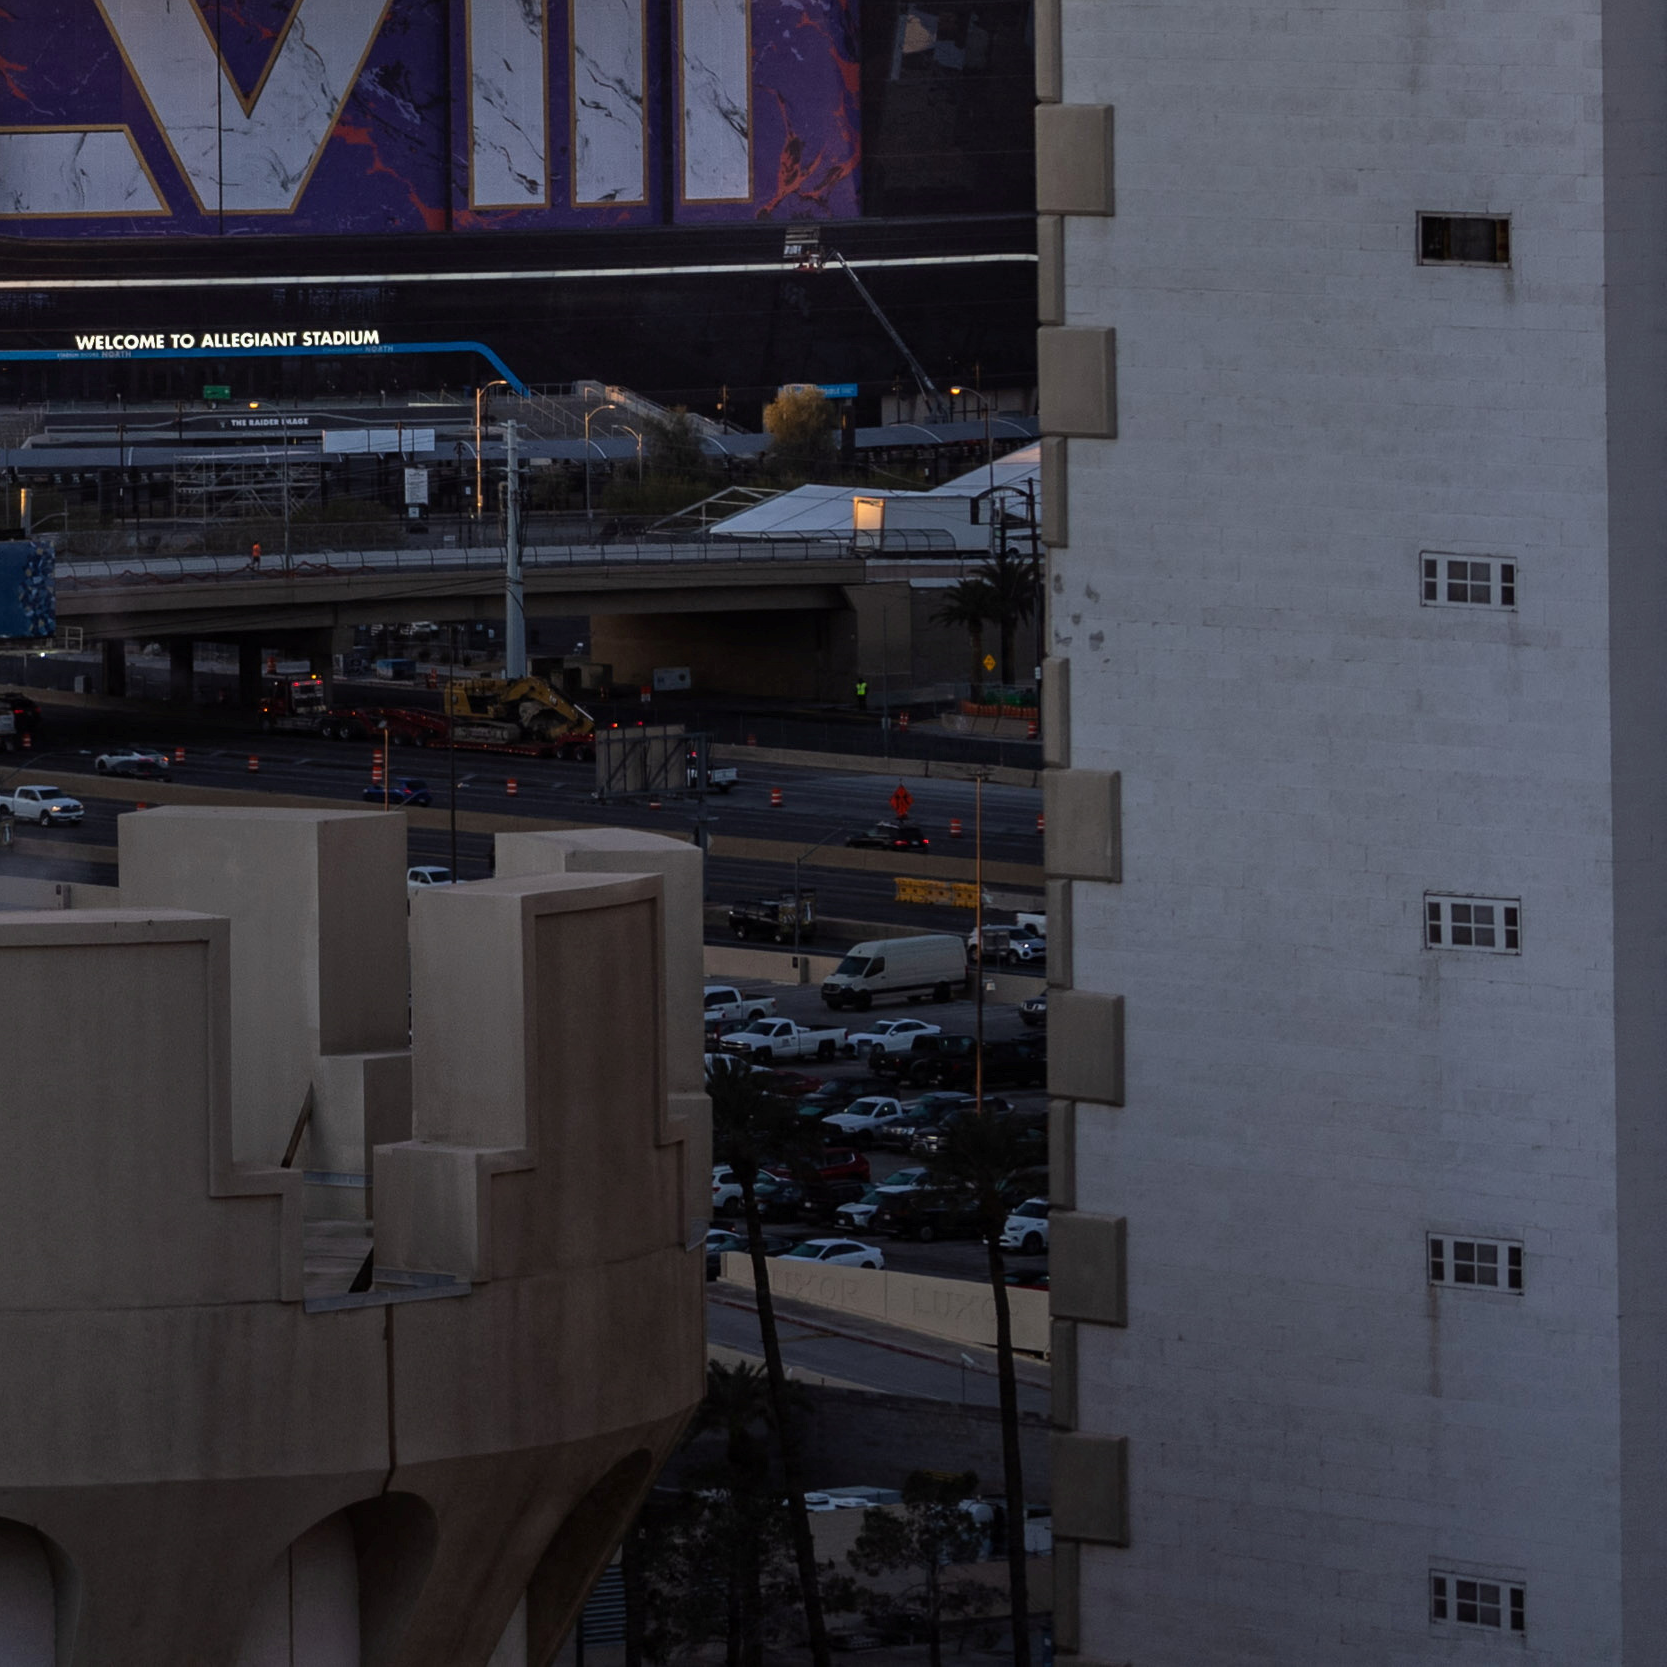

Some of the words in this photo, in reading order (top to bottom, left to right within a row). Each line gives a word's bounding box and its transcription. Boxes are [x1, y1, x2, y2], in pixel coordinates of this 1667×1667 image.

[75, 334, 165, 350] WELCOME
[170, 334, 195, 349] TO
[201, 332, 295, 348] ALLEGIANT
[302, 330, 380, 346] STADIUM
[101, 351, 132, 359] NORTH
